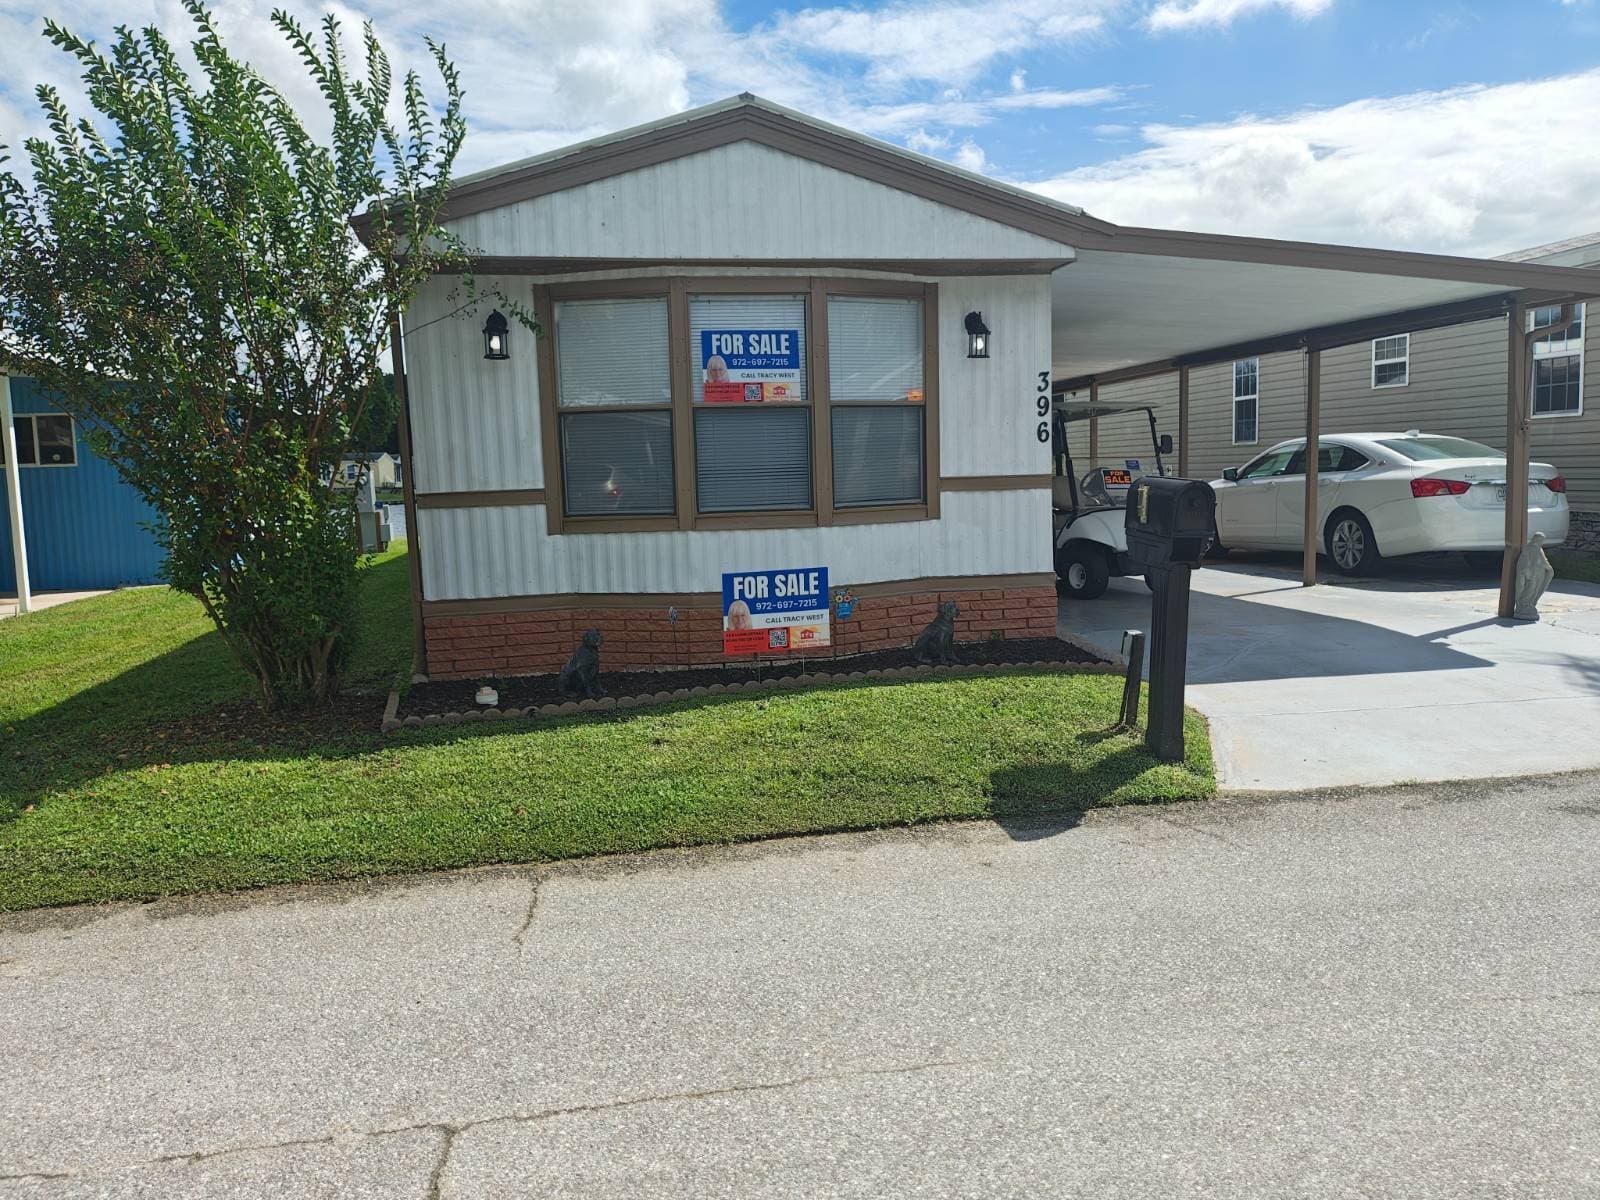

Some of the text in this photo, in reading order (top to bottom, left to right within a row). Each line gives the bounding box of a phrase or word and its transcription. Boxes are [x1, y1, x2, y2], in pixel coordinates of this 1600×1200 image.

[711, 333, 790, 355] FOR SALE
[732, 358, 789, 366] 972-697-7215
[1037, 371, 1050, 443] 396
[733, 572, 819, 600] FOR SALE
[755, 599, 818, 611] 972-697-7215
[783, 615, 805, 623] TRACY
[806, 613, 824, 621] WEST
